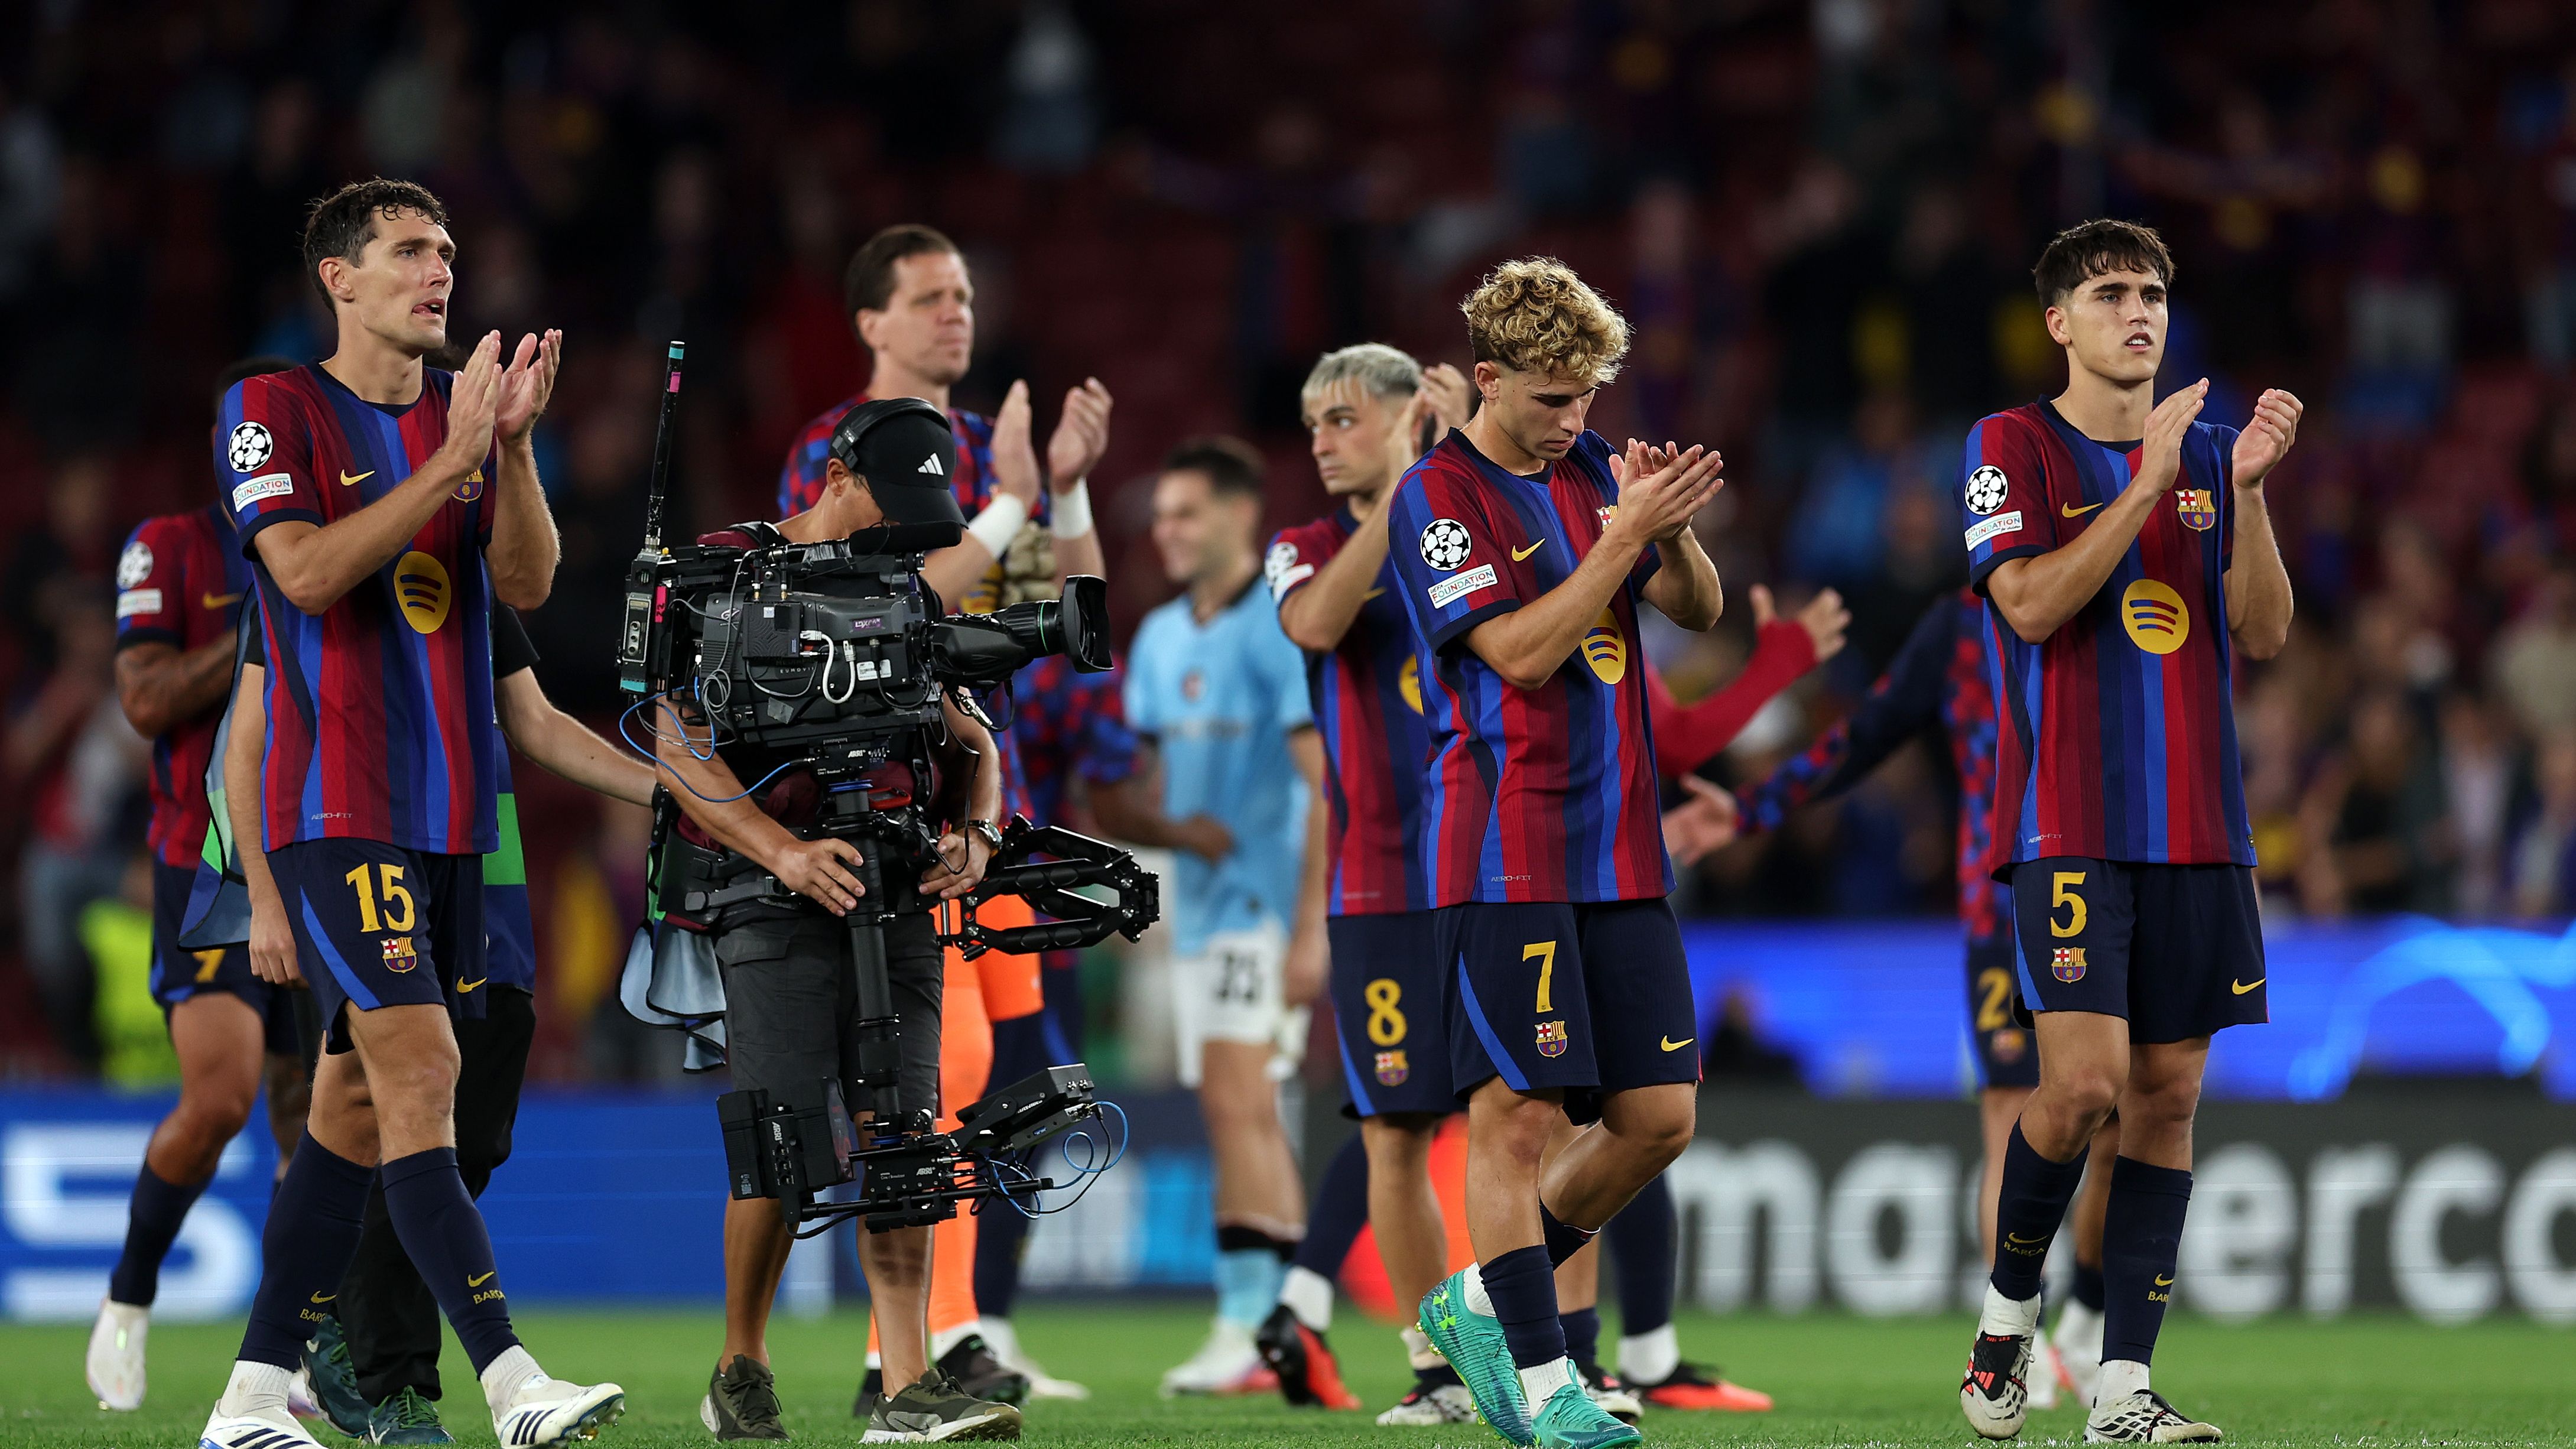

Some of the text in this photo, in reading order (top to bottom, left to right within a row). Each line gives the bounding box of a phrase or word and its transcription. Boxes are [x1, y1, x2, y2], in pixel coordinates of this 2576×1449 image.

[242, 436, 254, 457] 5
[235, 480, 290, 502] FOUNDATION
[1980, 479, 1992, 501] 5
[1967, 517, 2020, 542] FOUNDATION
[1438, 534, 1453, 555] 5
[1432, 571, 1493, 601] FOUNDATION
[346, 863, 415, 933] 15
[2050, 872, 2087, 938] 5
[1522, 940, 1557, 1013] 7
[1364, 977, 1408, 1035] 8
